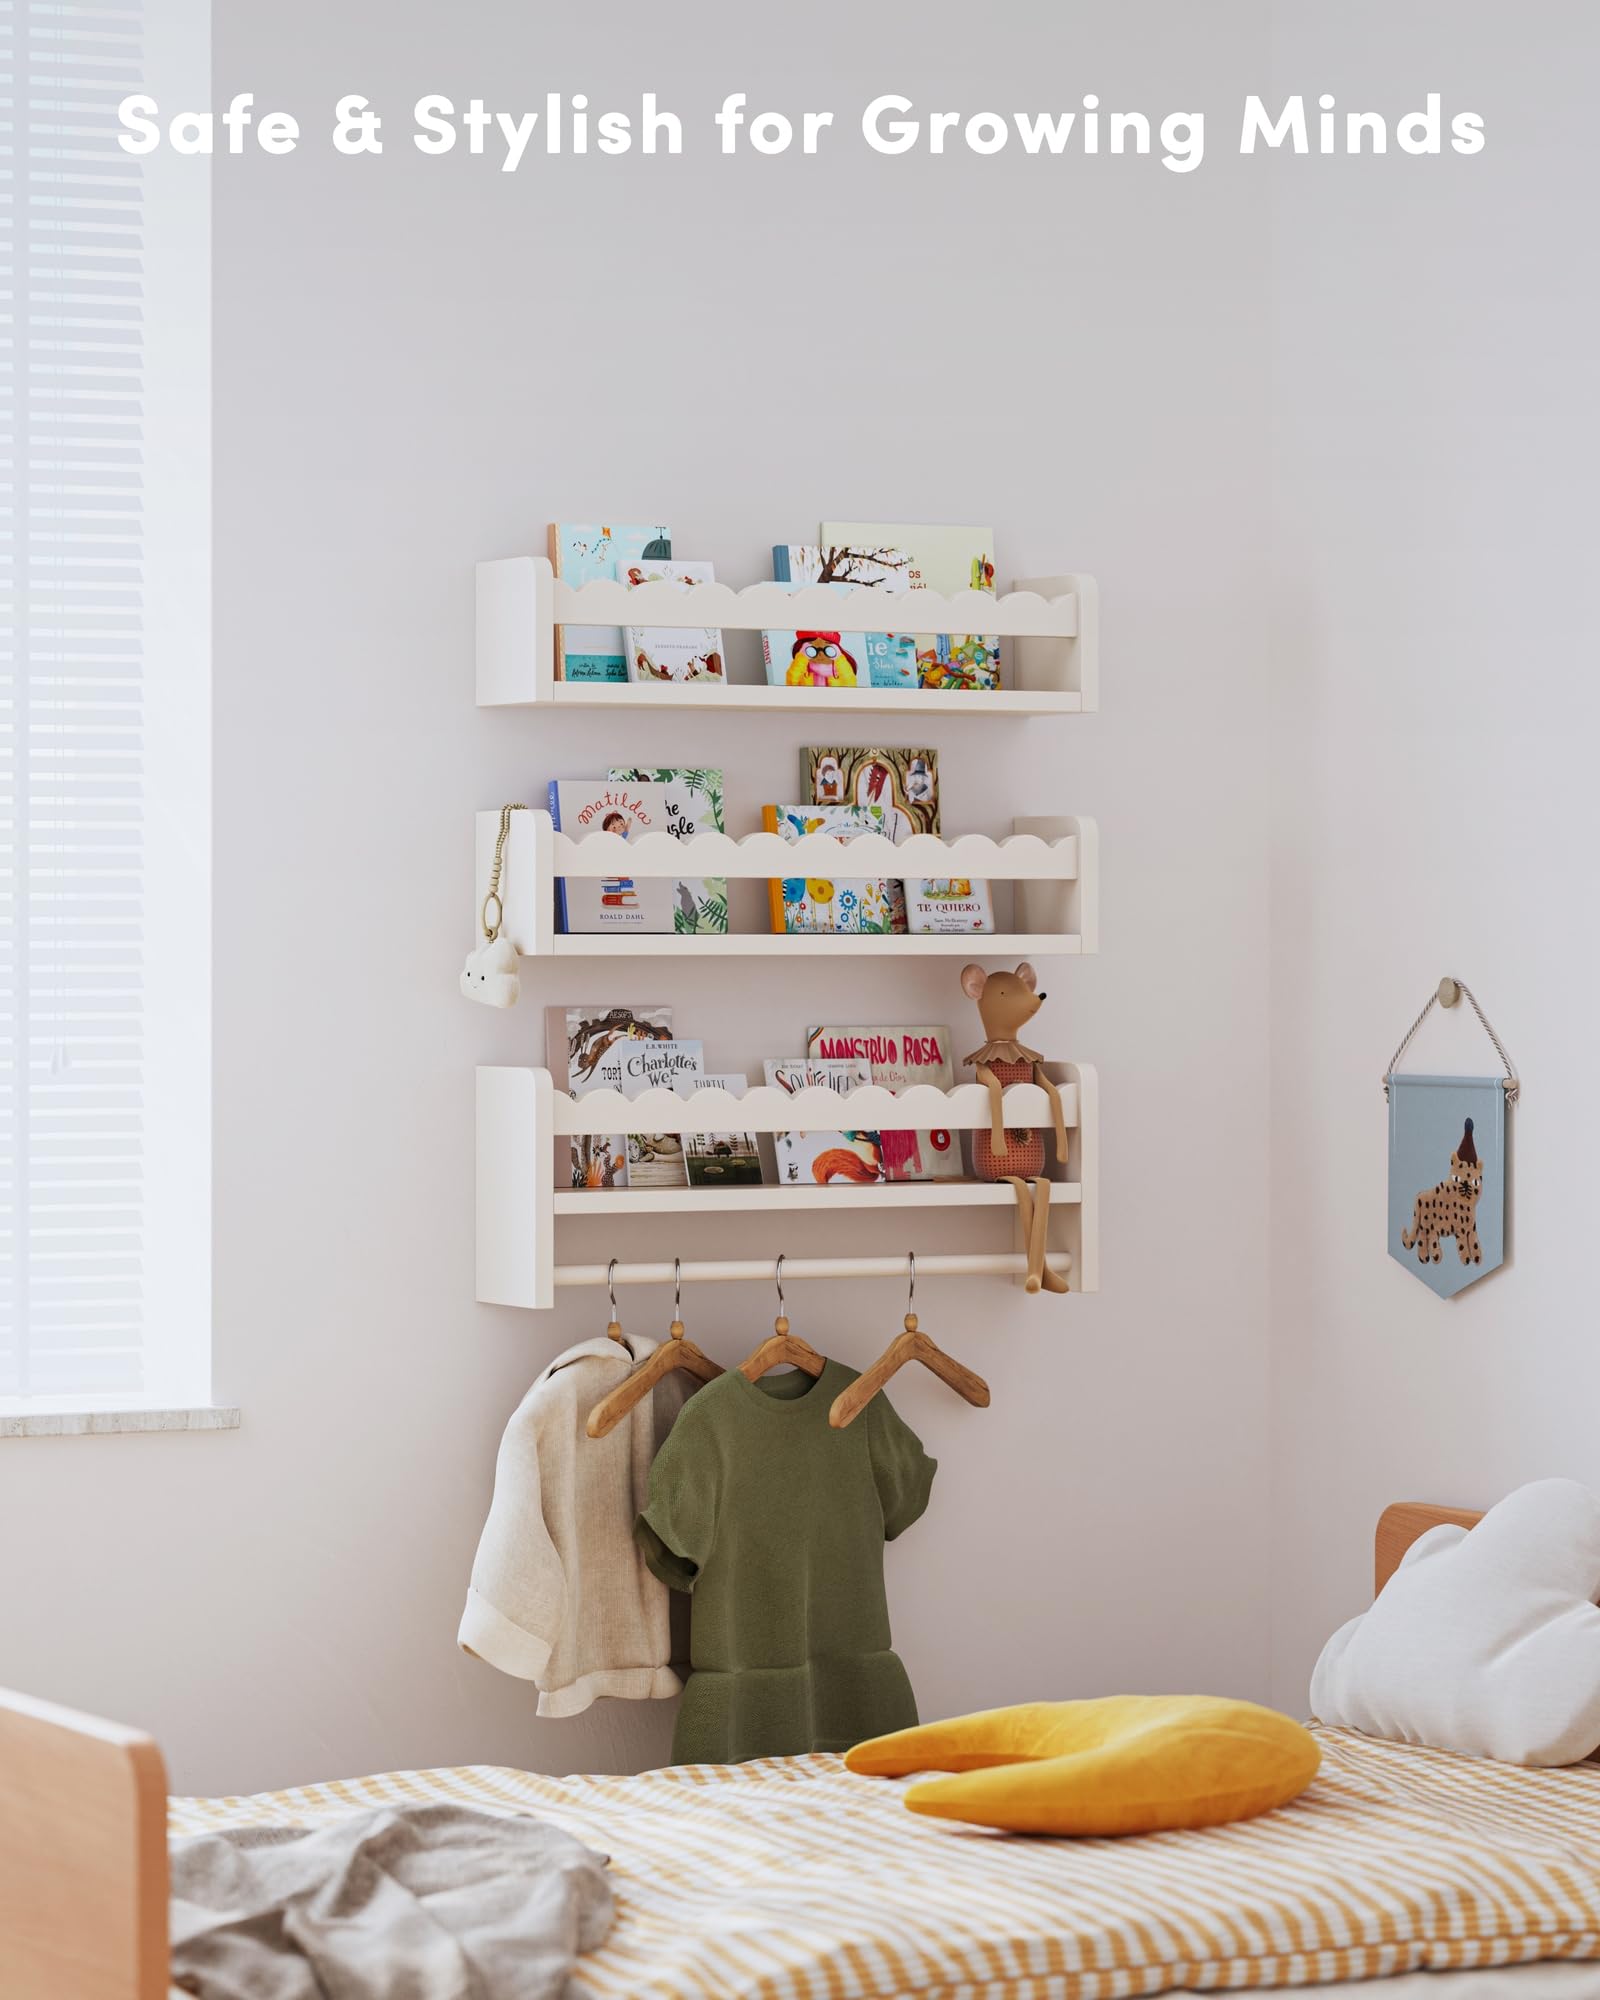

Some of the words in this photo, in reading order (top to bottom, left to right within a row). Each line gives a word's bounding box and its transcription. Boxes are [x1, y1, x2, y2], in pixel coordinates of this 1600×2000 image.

[578, 791, 652, 825] Matilda
[917, 903, 932, 912] TE
[936, 903, 981, 914] QUIERO
[627, 1052, 698, 1077] Charlotte's
[820, 1035, 898, 1065] MONSTRUO
[903, 1034, 945, 1067] ROSA
